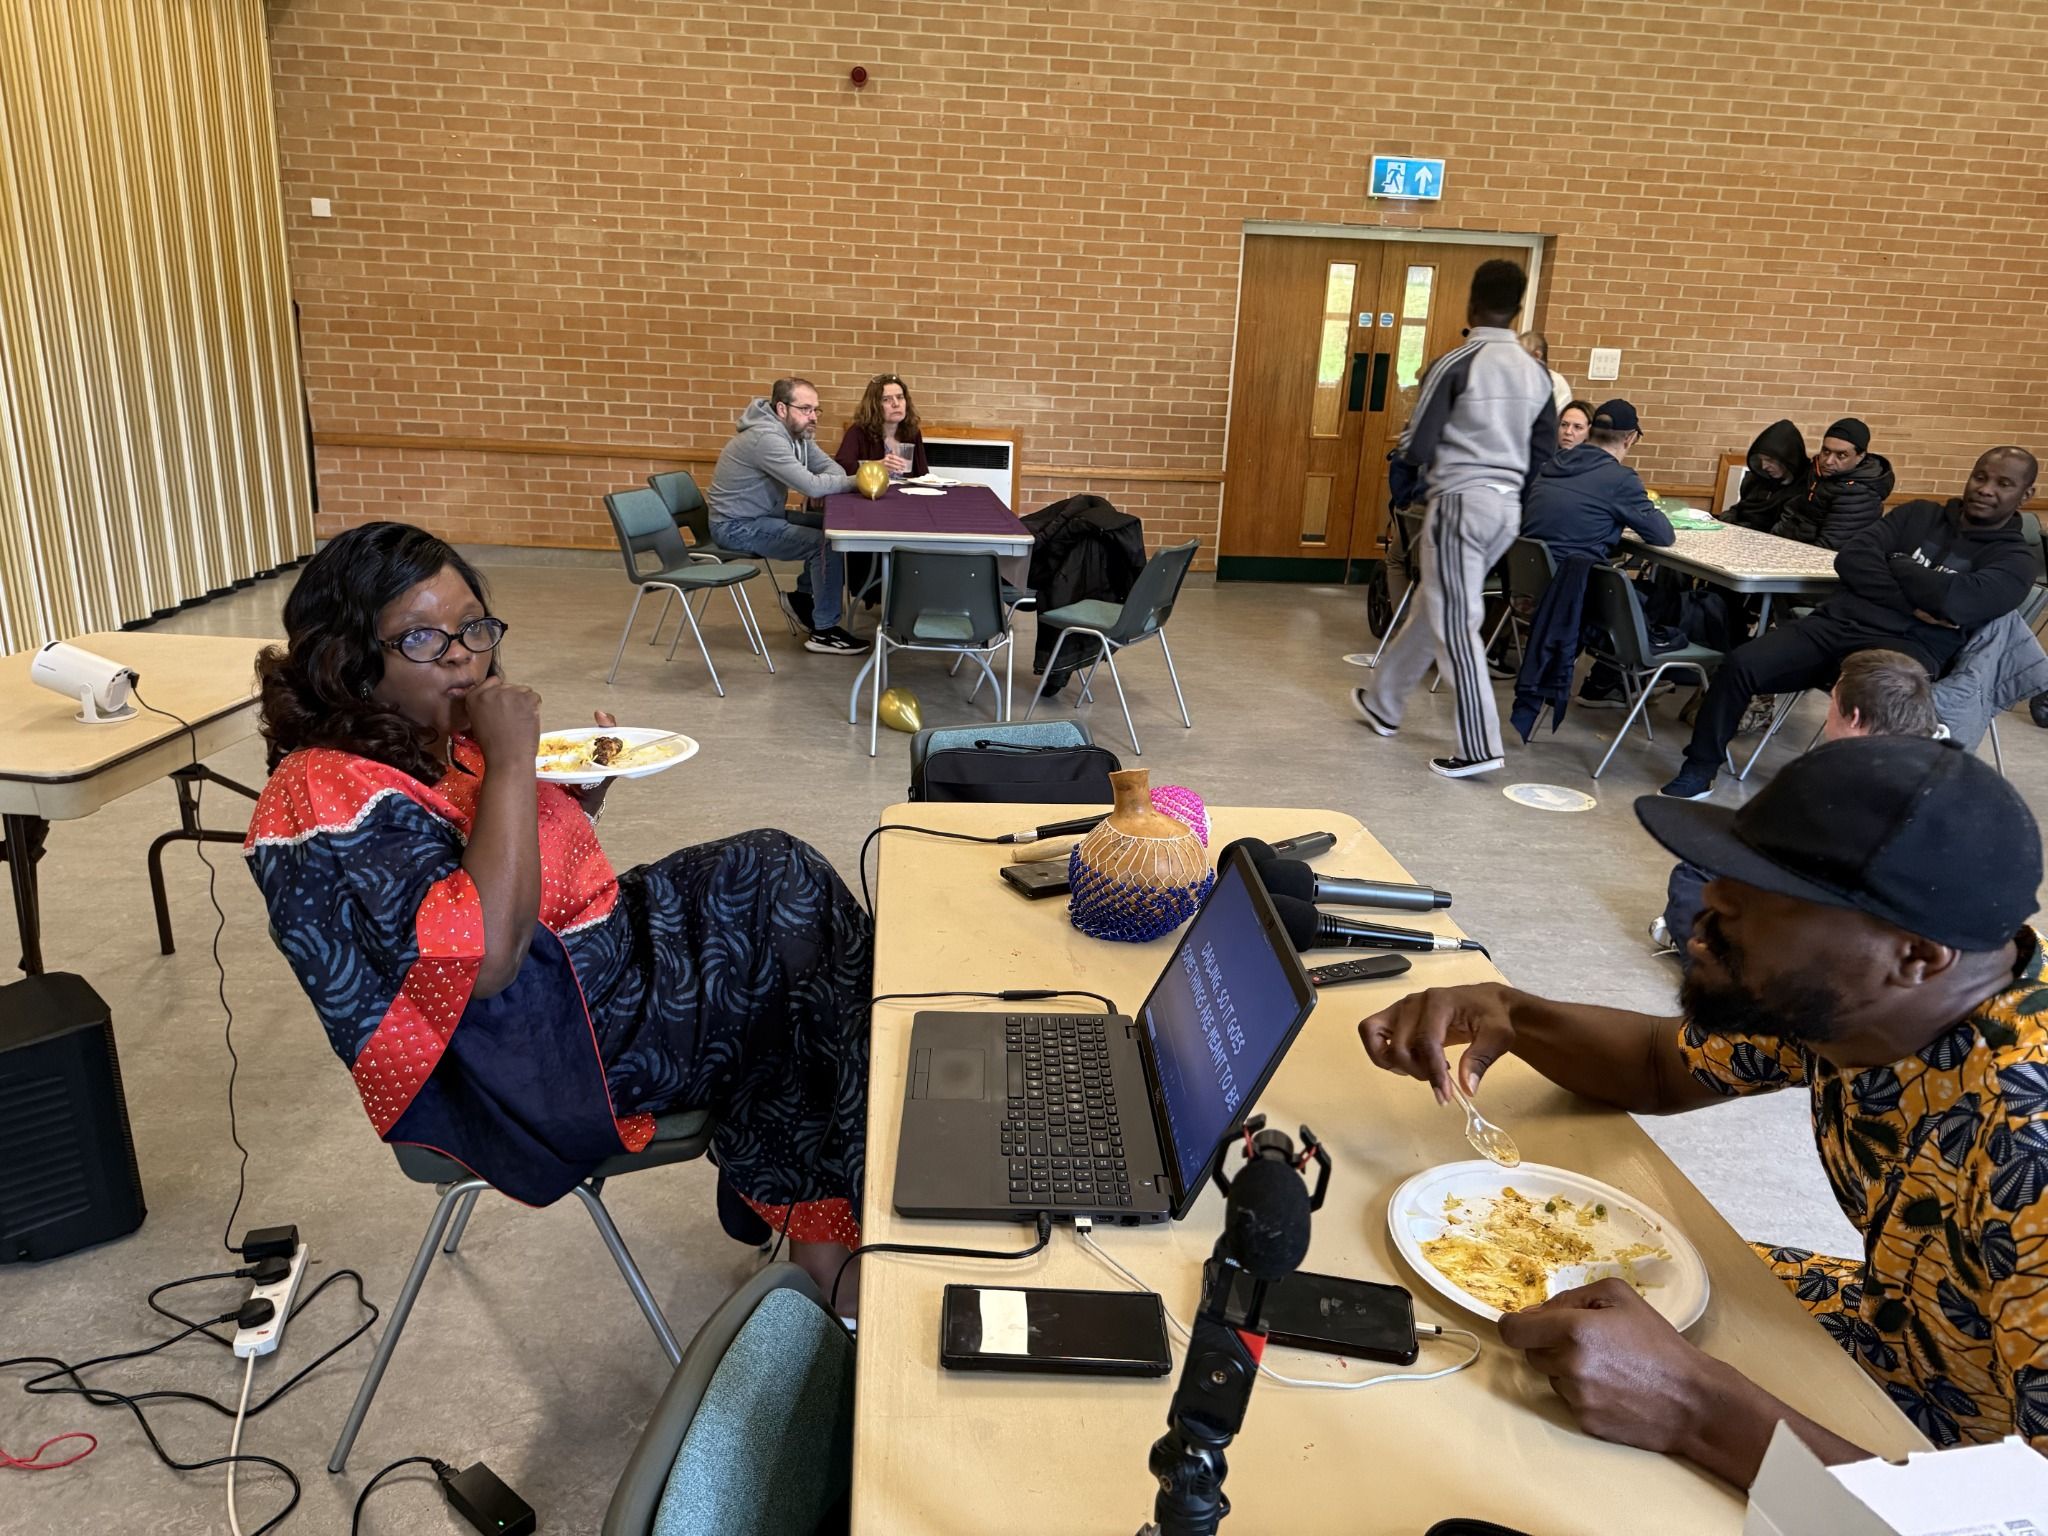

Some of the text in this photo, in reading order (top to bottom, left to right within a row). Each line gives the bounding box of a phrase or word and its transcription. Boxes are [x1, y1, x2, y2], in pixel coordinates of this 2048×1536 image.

[1217, 988, 1230, 1010] SO
[1222, 1003, 1235, 1024] IT
[1182, 943, 1239, 1112] SOME THINGS ARE MEANT TO BE
[1227, 1018, 1245, 1055] GOES
